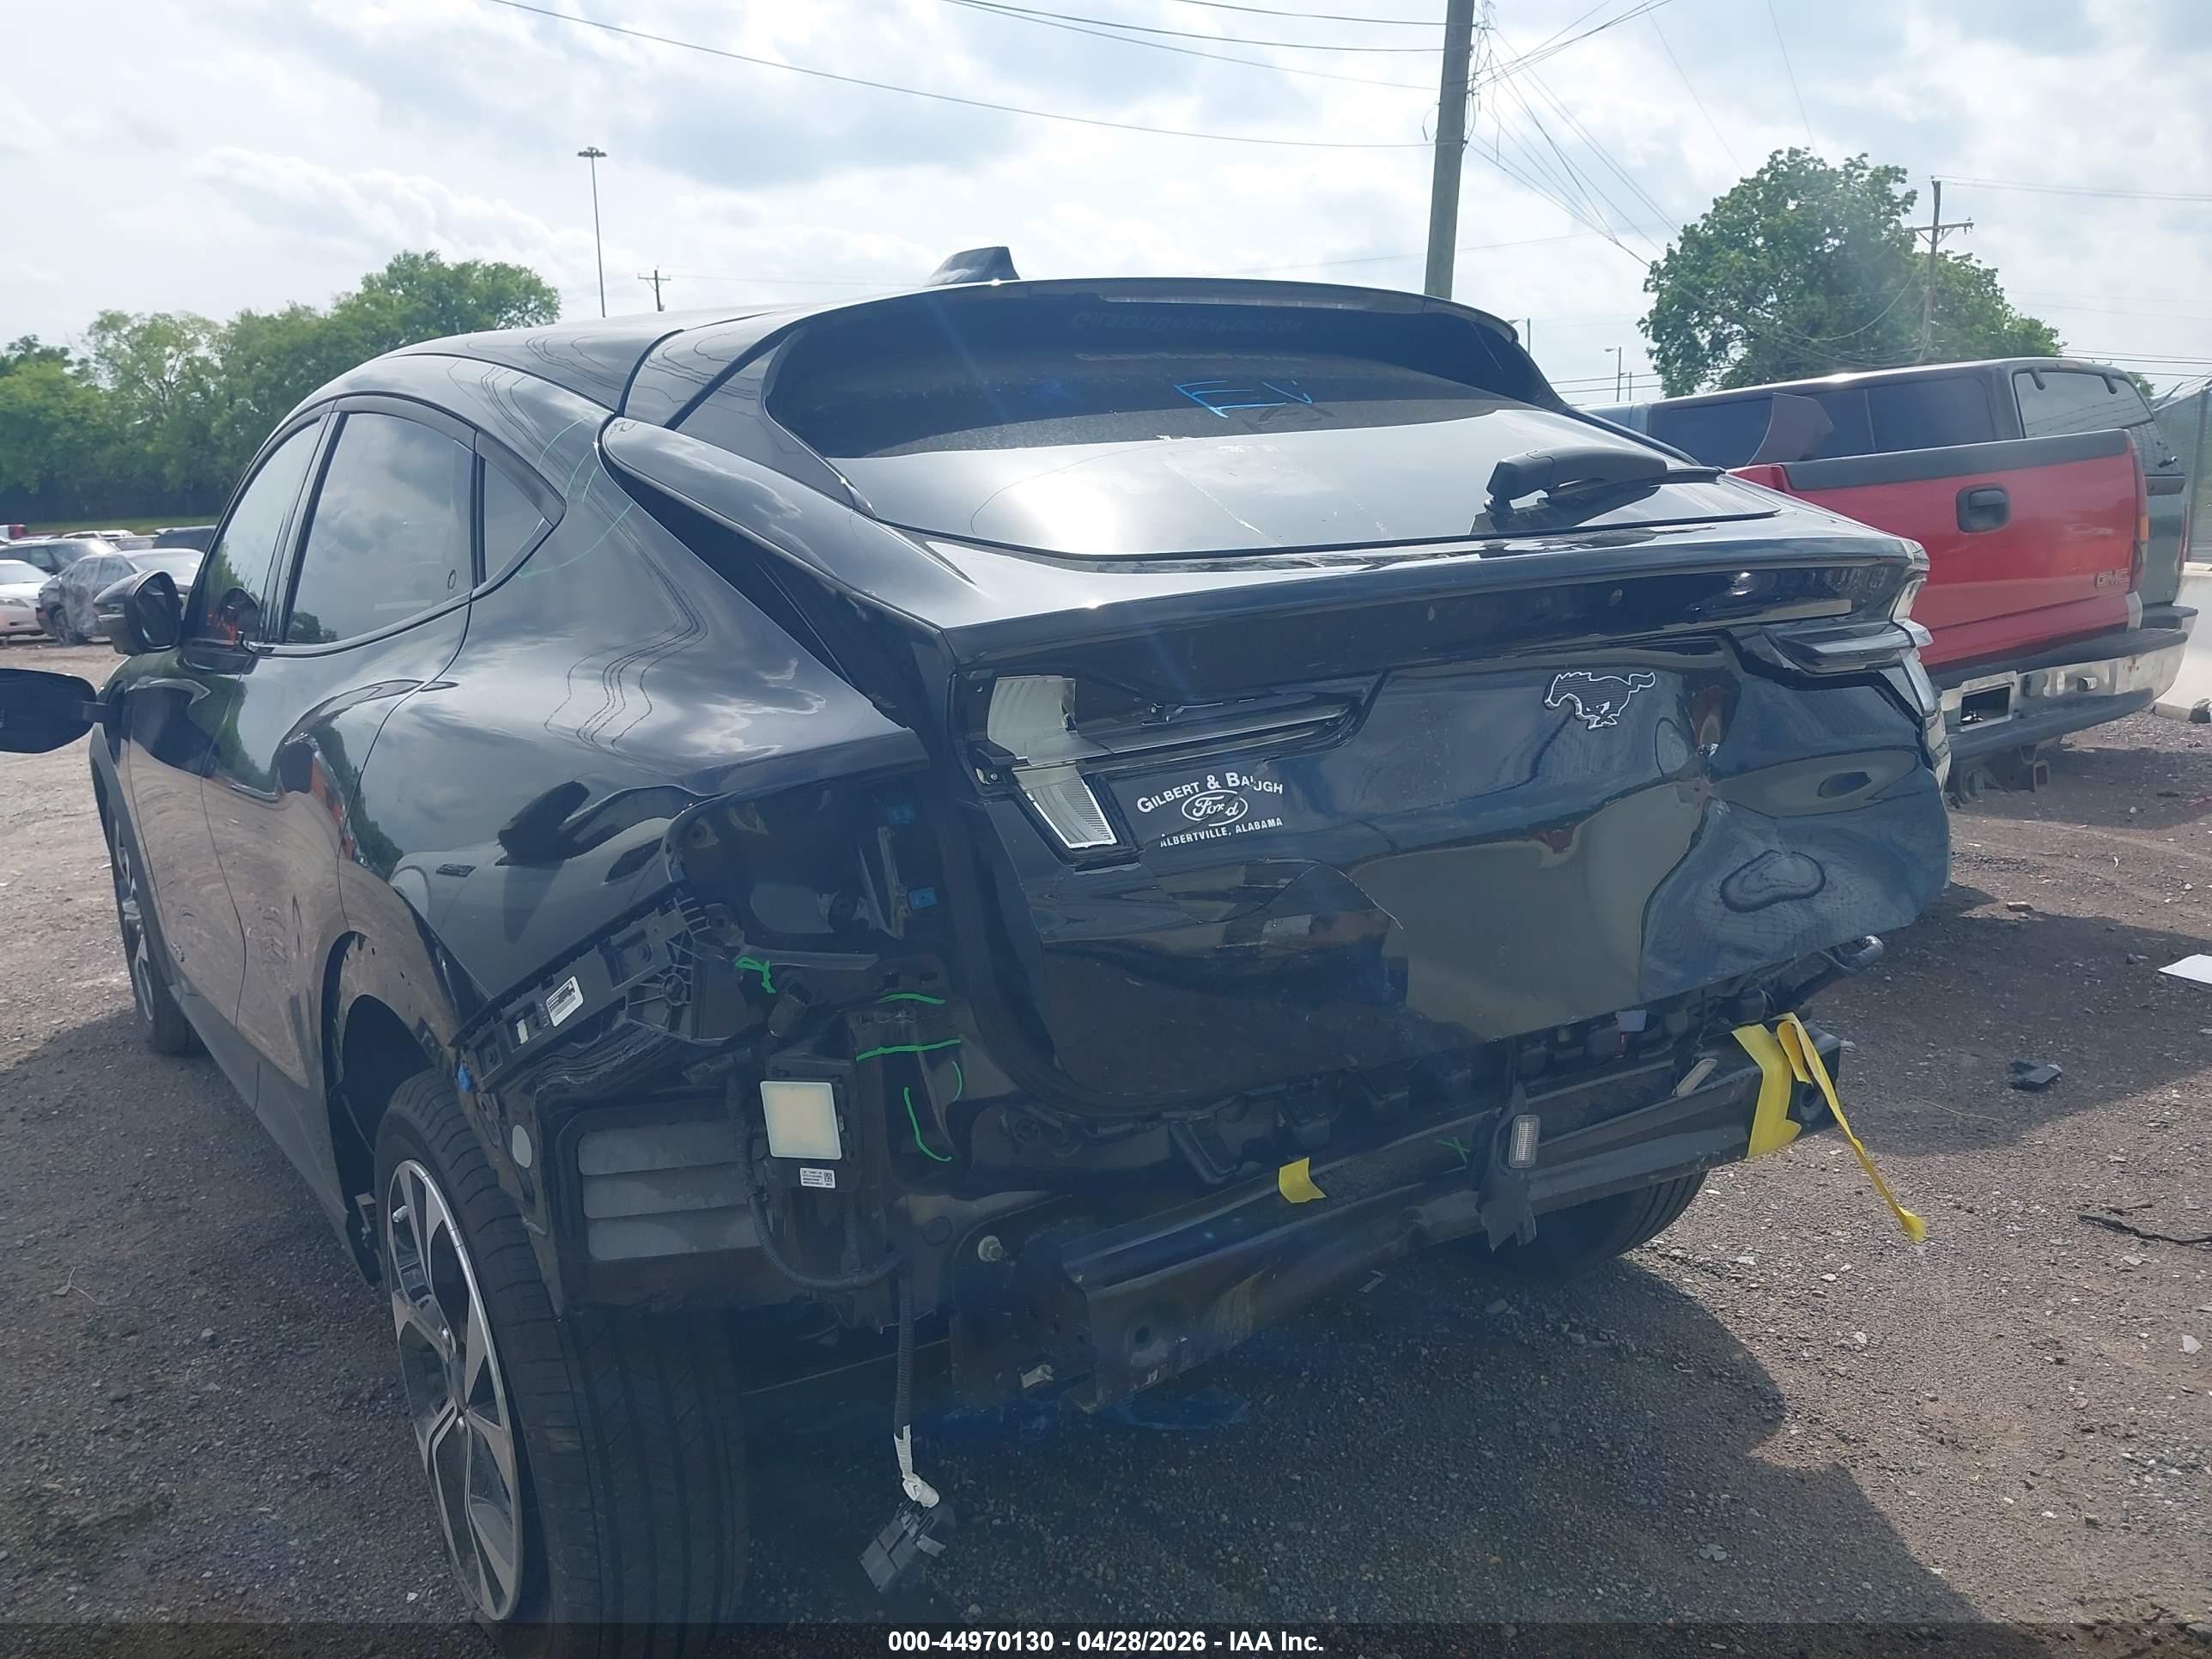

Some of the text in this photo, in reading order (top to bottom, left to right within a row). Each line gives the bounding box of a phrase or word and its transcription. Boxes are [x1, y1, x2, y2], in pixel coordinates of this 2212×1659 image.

[2096, 568, 2130, 589] GMC
[1137, 782, 1200, 812] GILBERT
[1206, 775, 1223, 790] &
[1192, 794, 1239, 817] Ford
[1160, 817, 1284, 848] ALBERTVILLE, ALABAMA
